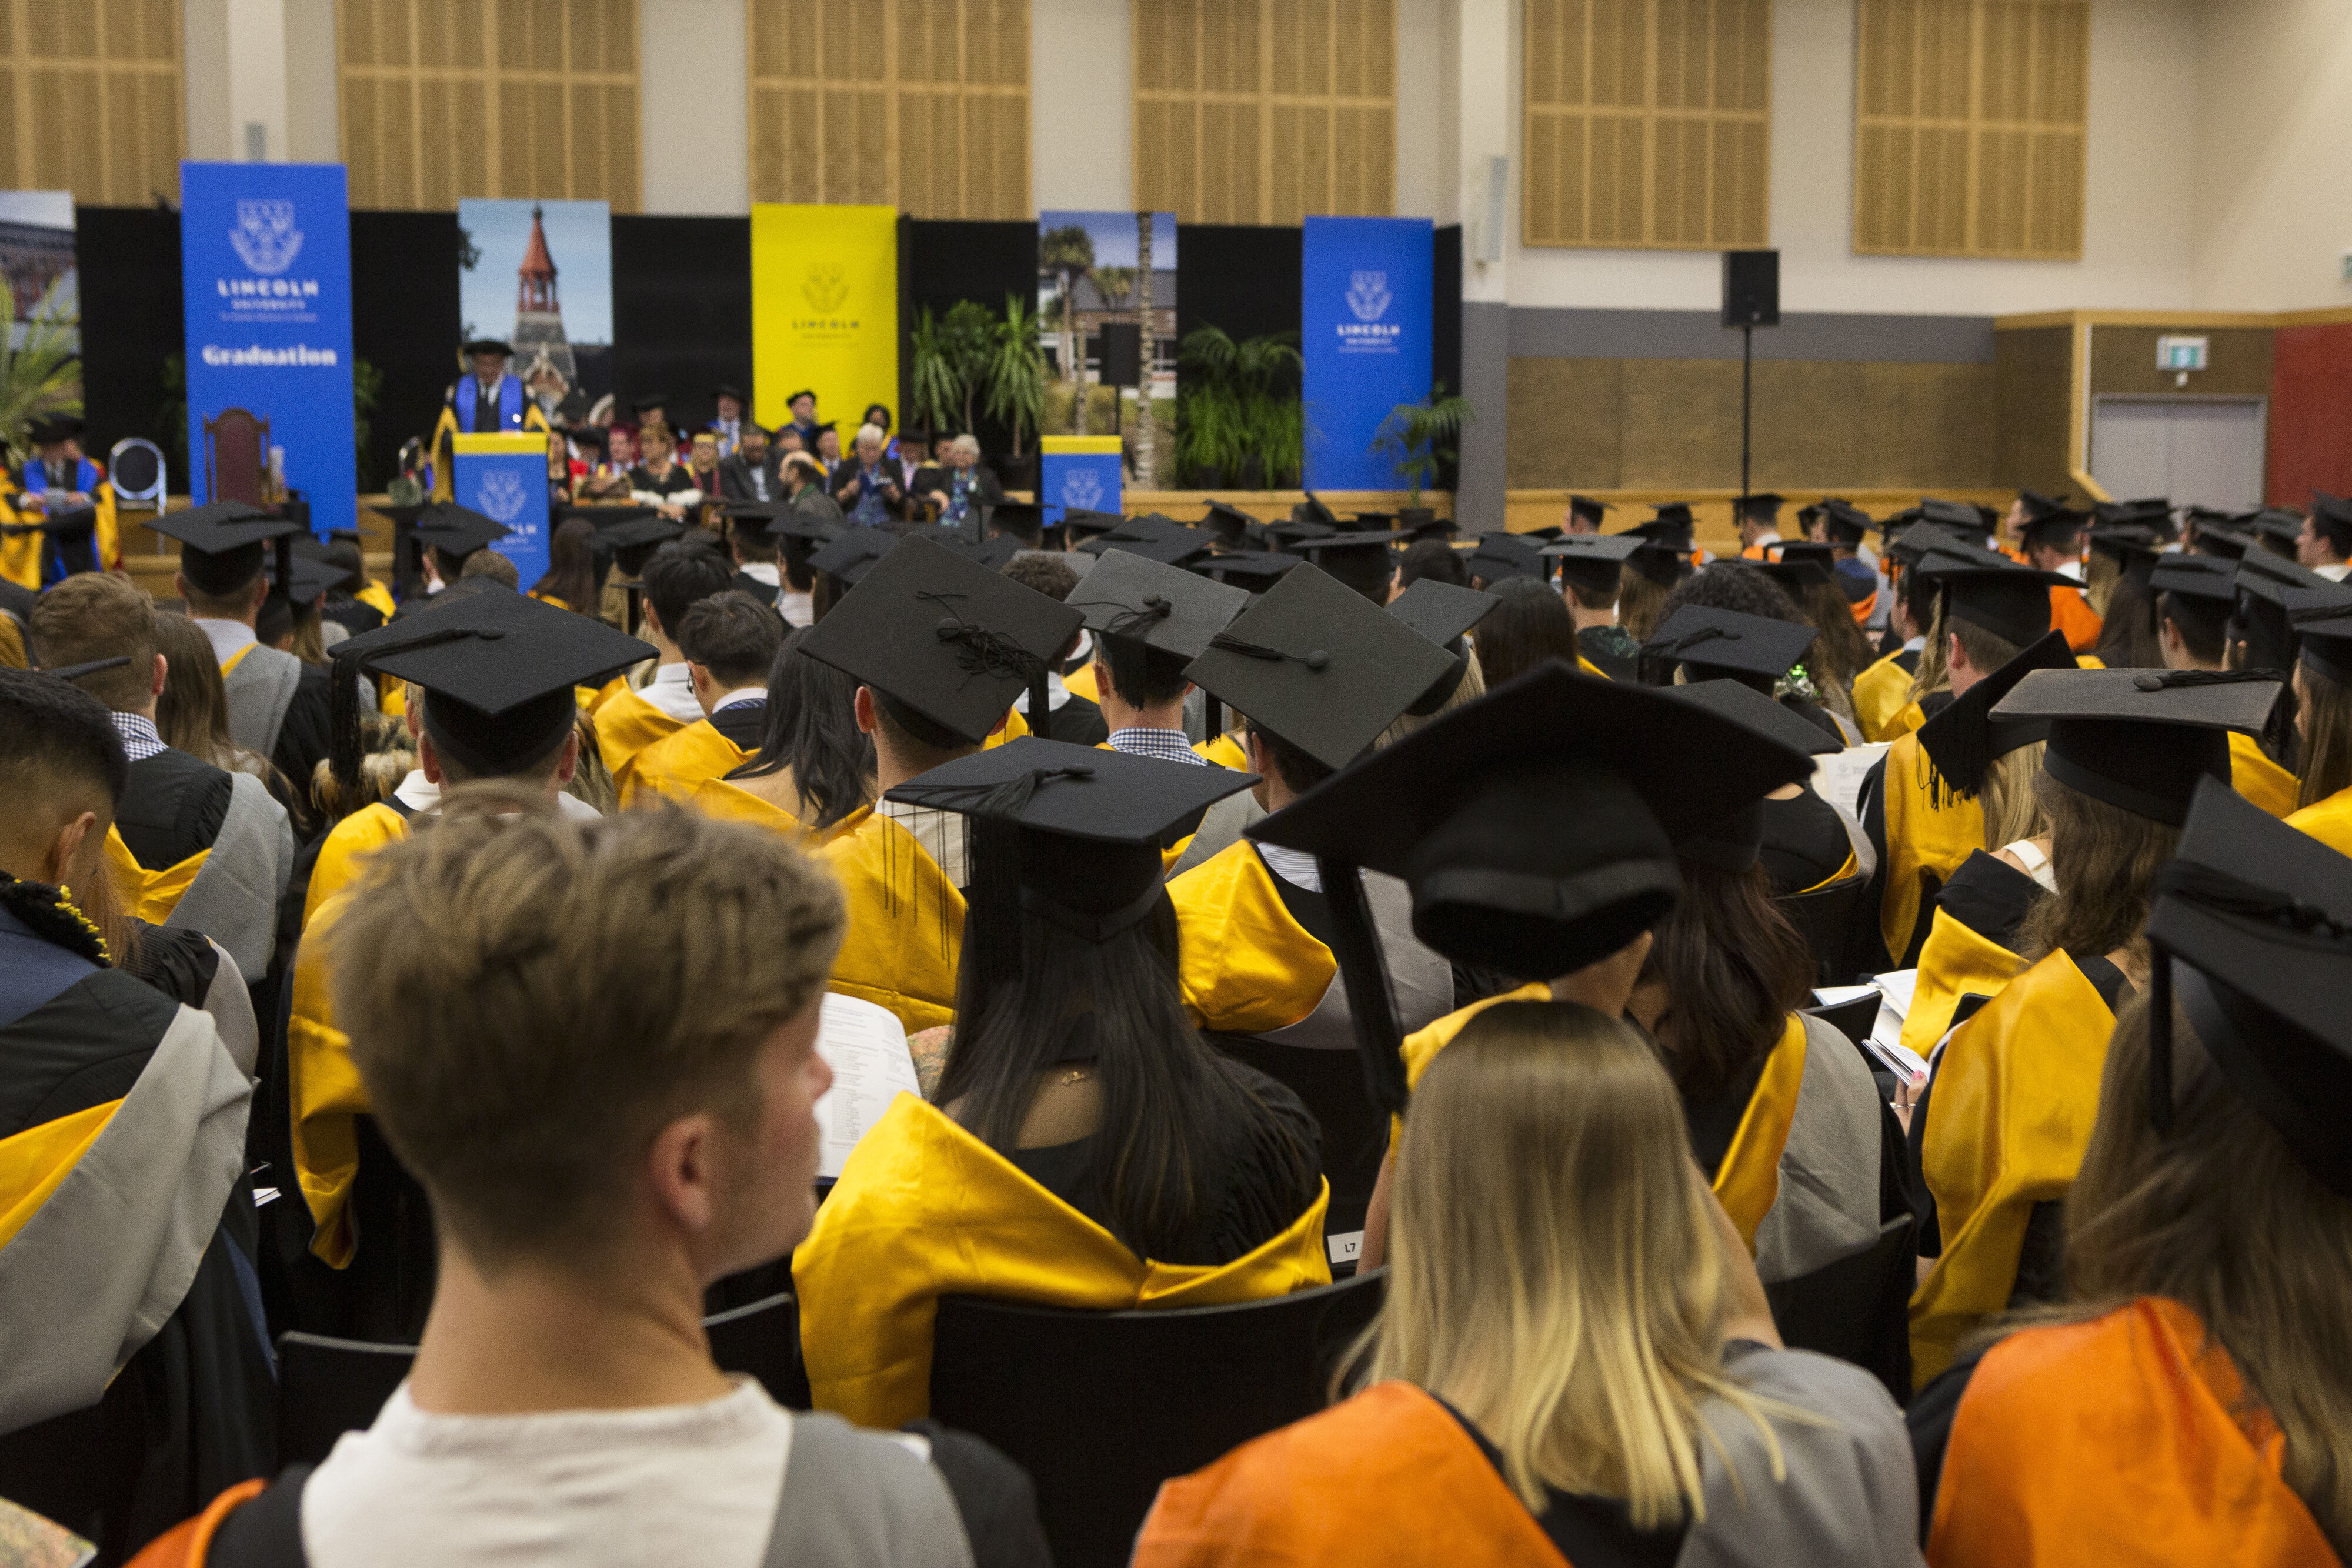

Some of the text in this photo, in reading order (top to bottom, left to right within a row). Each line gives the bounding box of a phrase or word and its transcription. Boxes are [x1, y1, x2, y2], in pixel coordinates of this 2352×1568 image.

[216, 278, 319, 297] LINCOLN
[202, 343, 338, 366] Graduation
[1345, 1242, 1356, 1253] L7
